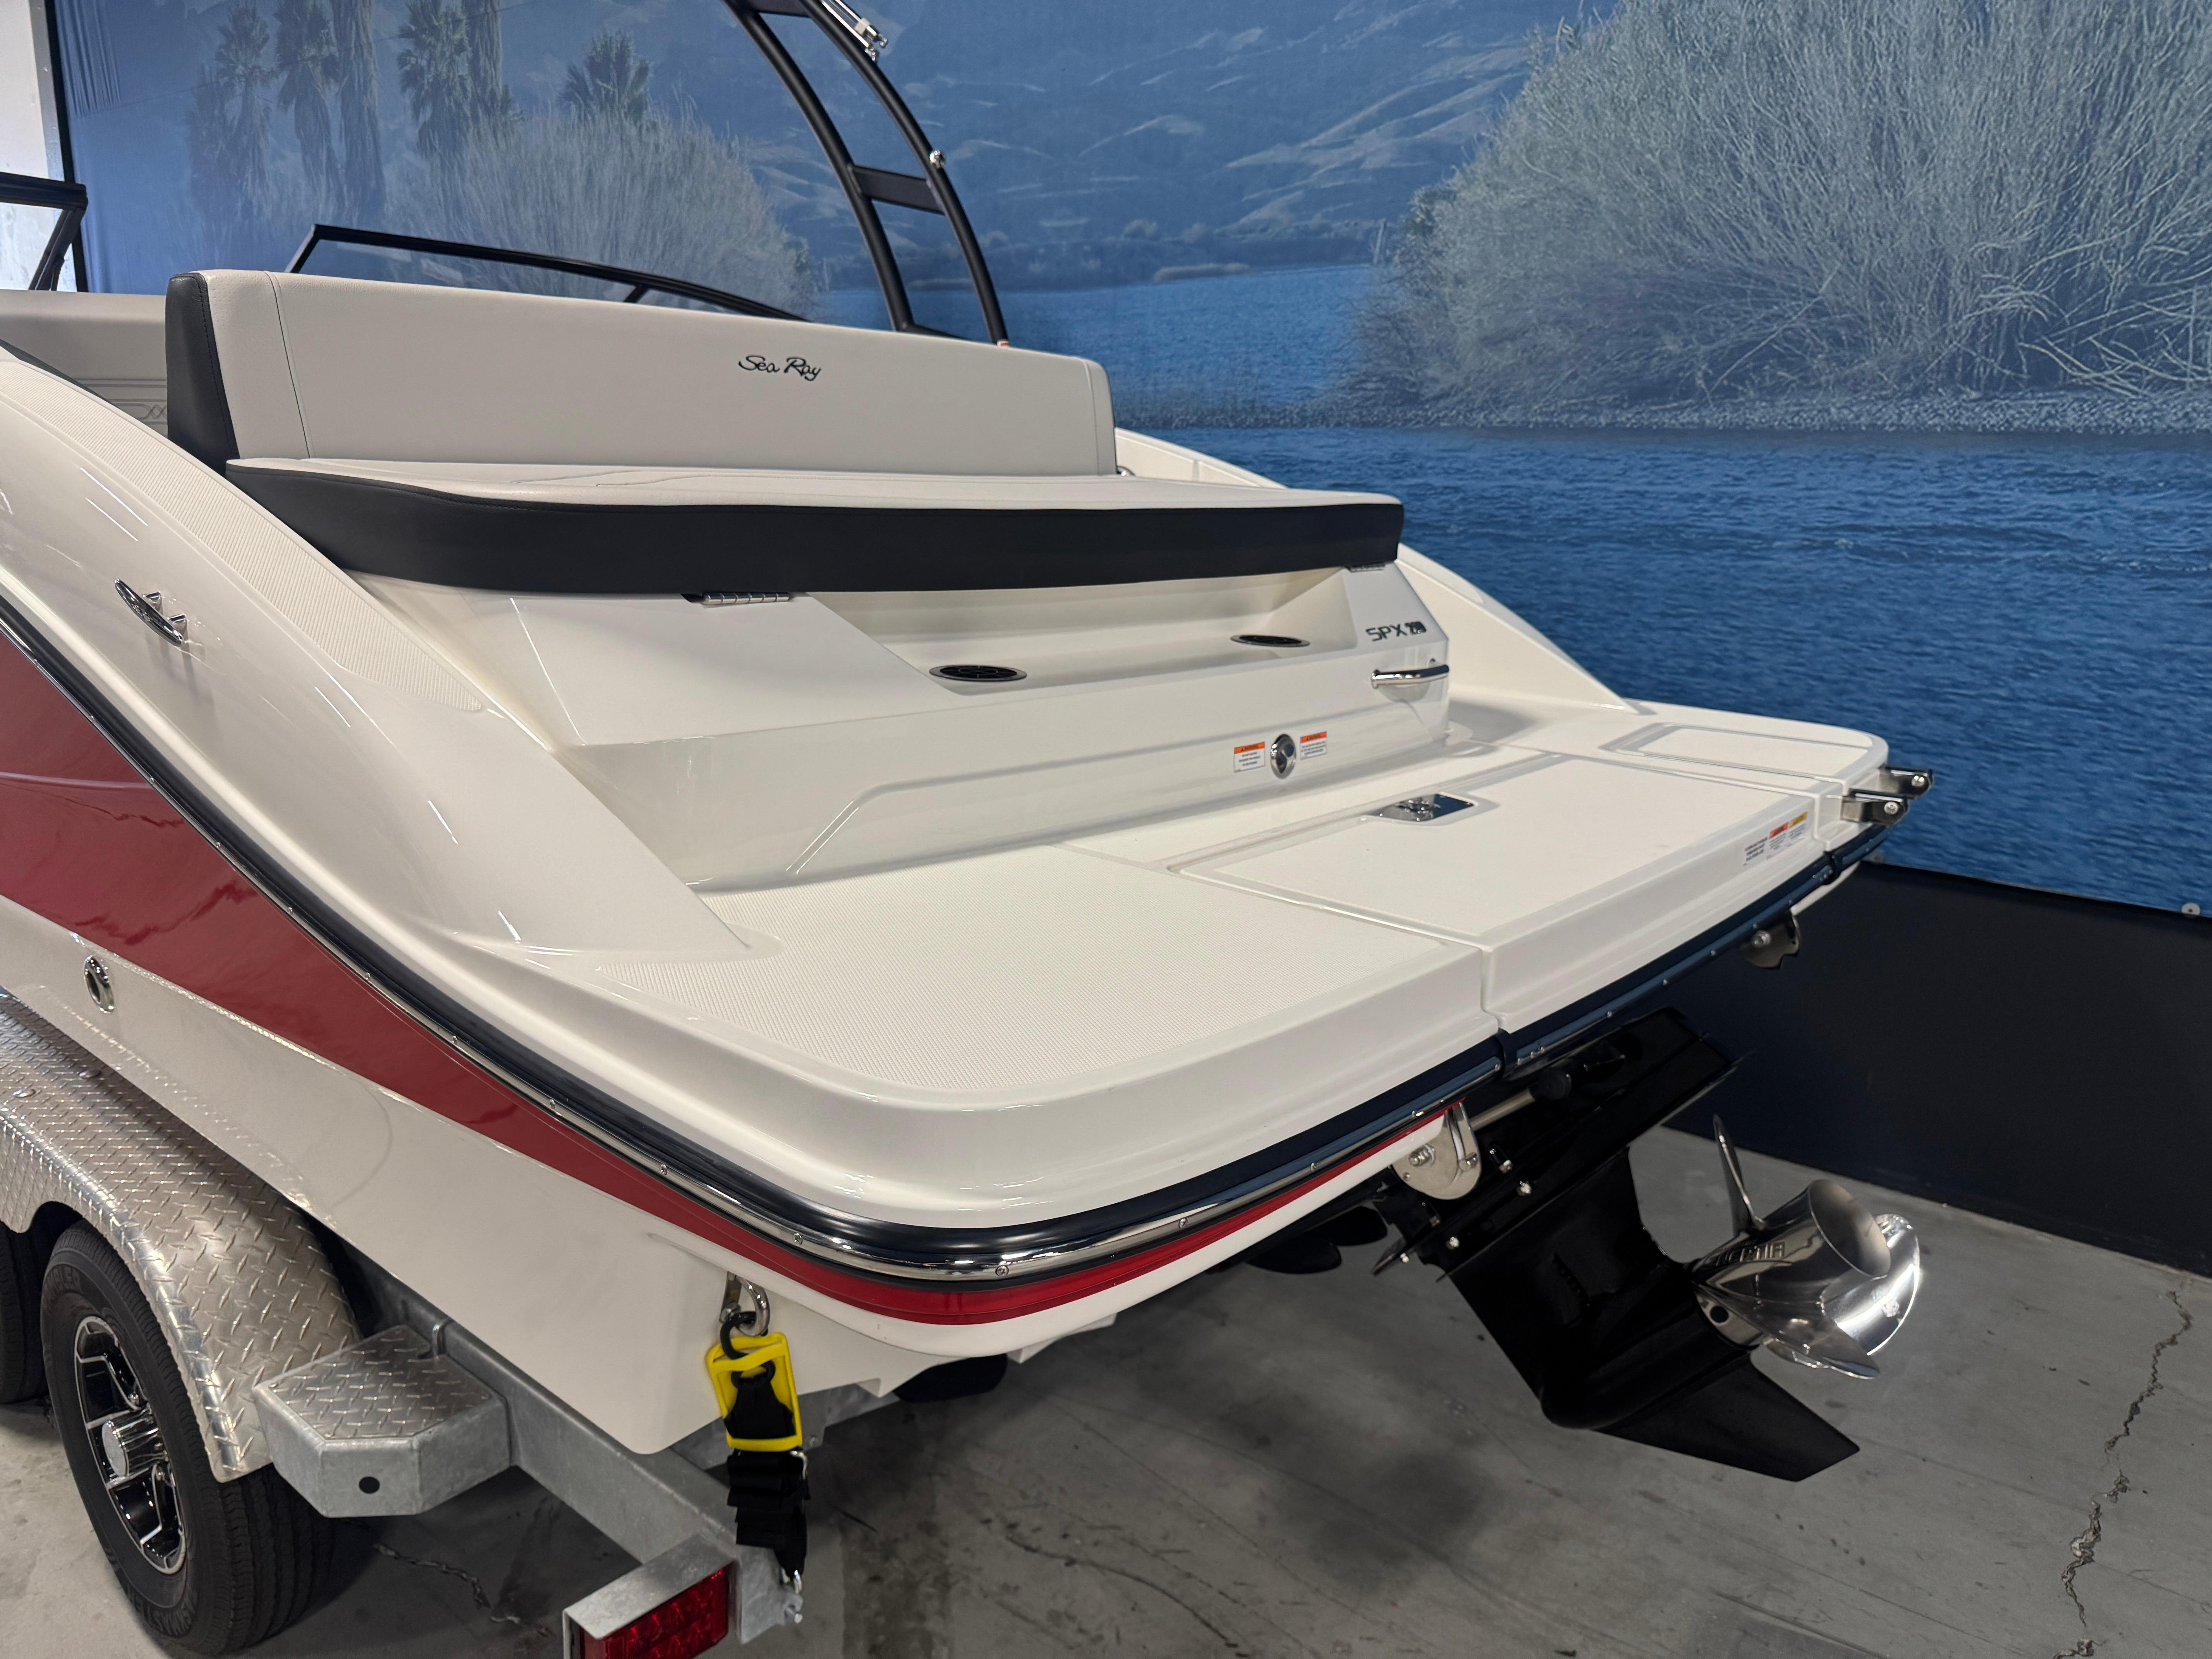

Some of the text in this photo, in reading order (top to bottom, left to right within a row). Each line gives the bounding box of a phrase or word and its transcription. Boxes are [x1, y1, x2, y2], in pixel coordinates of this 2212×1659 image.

[738, 355, 821, 381] Sea Ray
[1366, 624, 1407, 642] SPX
